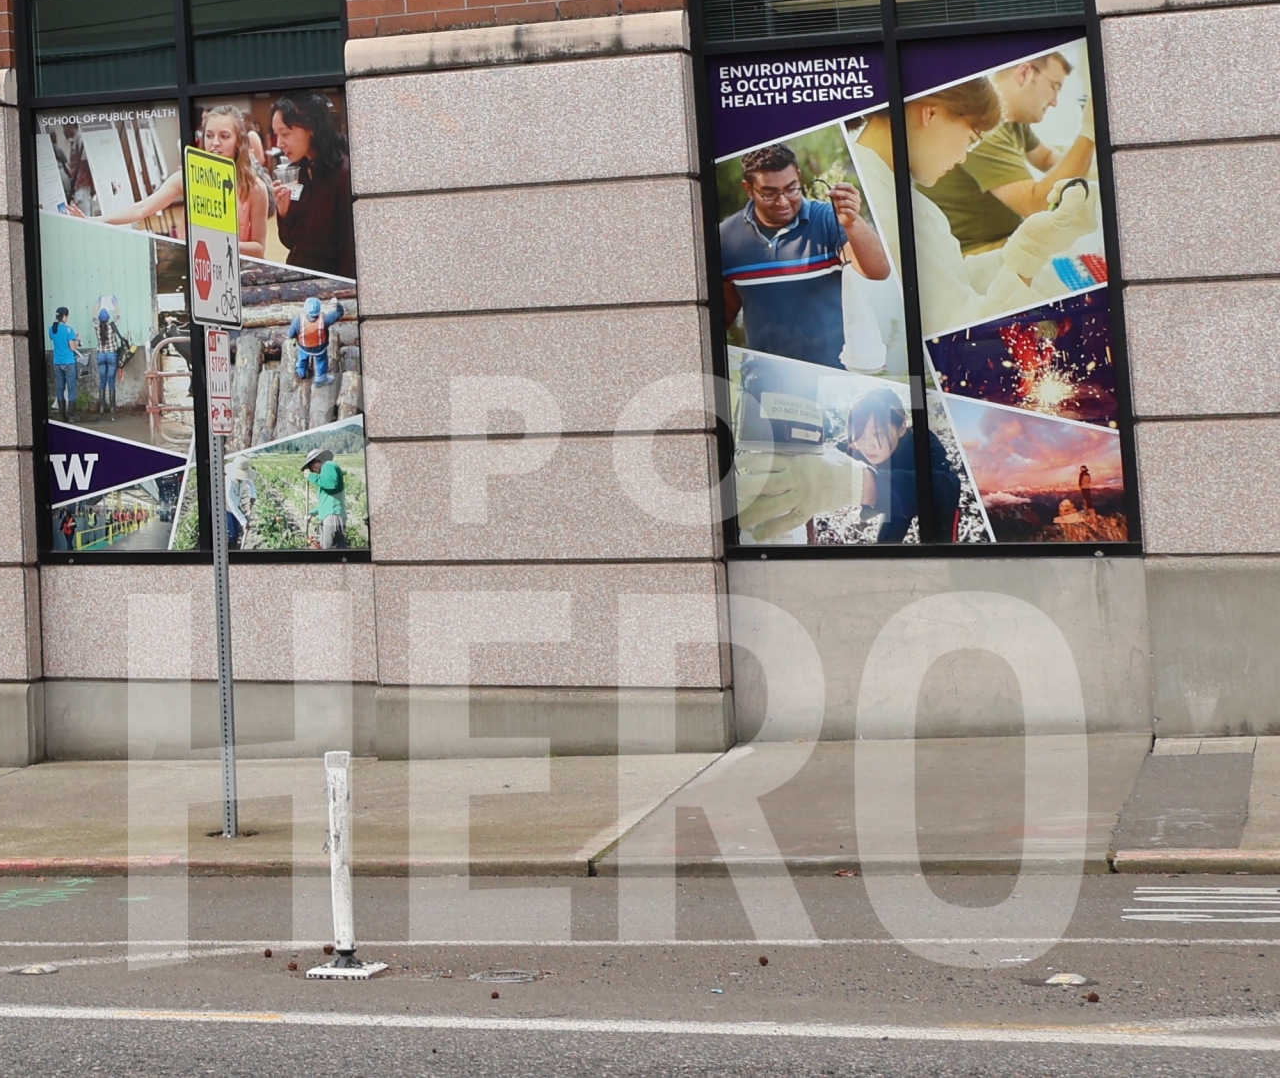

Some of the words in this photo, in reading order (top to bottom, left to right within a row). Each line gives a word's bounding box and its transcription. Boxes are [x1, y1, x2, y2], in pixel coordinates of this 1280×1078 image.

[719, 56, 869, 79] ENVIRONMENTAL
[720, 81, 732, 93] &
[736, 71, 868, 93] OCCUPATIONAL
[721, 91, 788, 108] HEALTH
[792, 85, 874, 103] SCIENCES
[42, 115, 82, 126] SCHOOL
[83, 114, 97, 124] OF
[99, 111, 135, 122] PUBLIC
[136, 108, 176, 119] HEALTH
[190, 164, 222, 190] TURNING
[191, 193, 223, 220] VEHICLES
[195, 259, 211, 282] STOP
[213, 264, 223, 281] FOR
[50, 453, 98, 490] W
